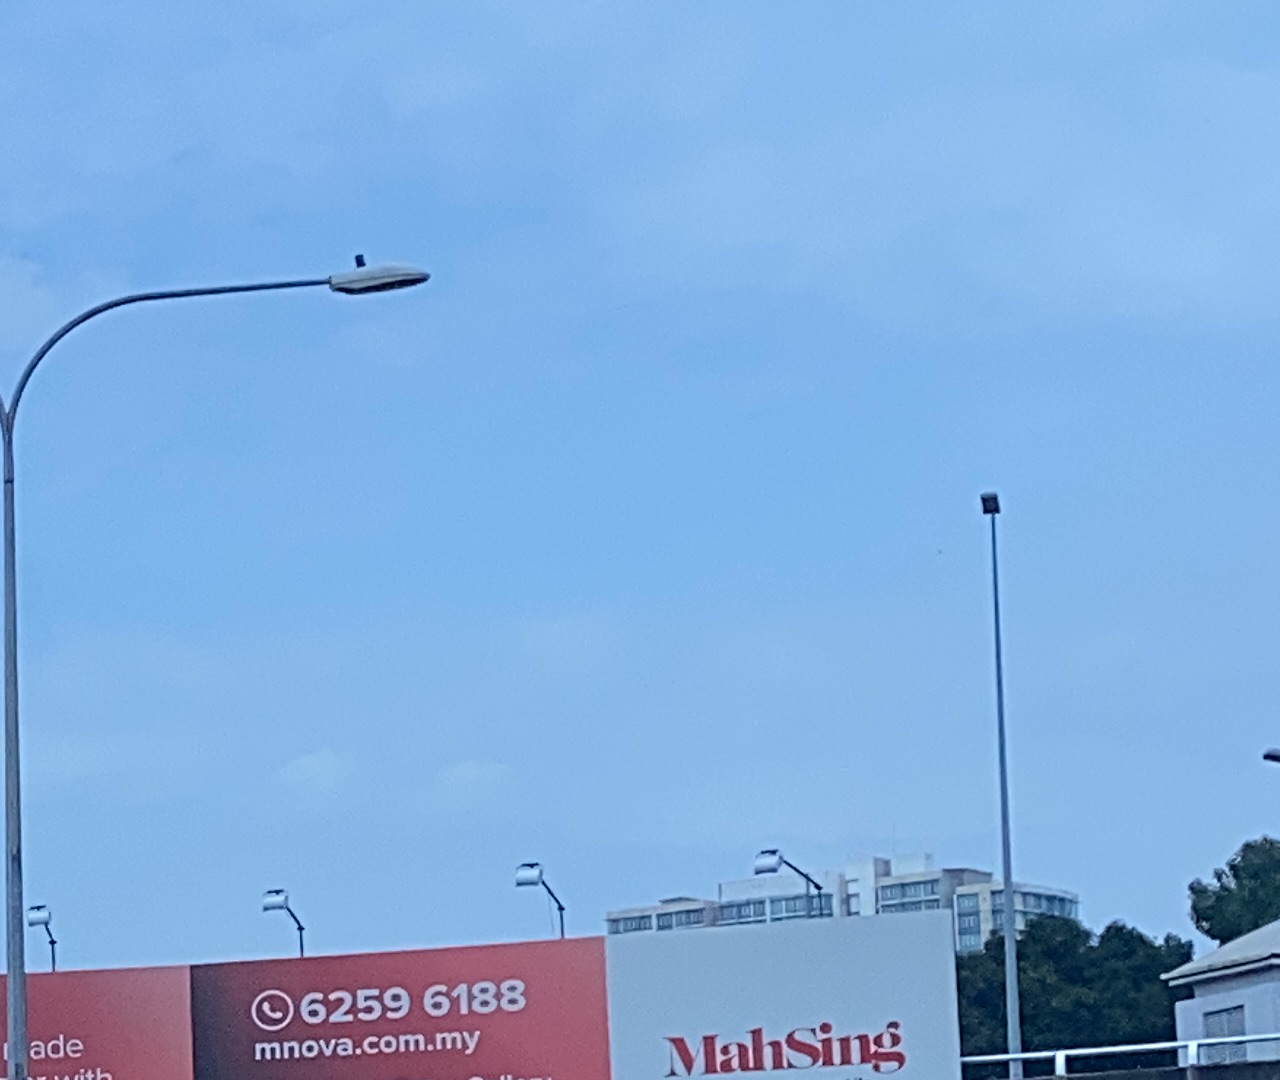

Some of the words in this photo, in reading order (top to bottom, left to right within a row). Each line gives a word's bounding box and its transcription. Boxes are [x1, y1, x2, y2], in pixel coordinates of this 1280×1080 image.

[299, 986, 412, 1024] 6259
[423, 979, 527, 1017] 6188
[254, 1030, 480, 1061] mnova.com.my
[662, 1021, 907, 1078] MahSing
